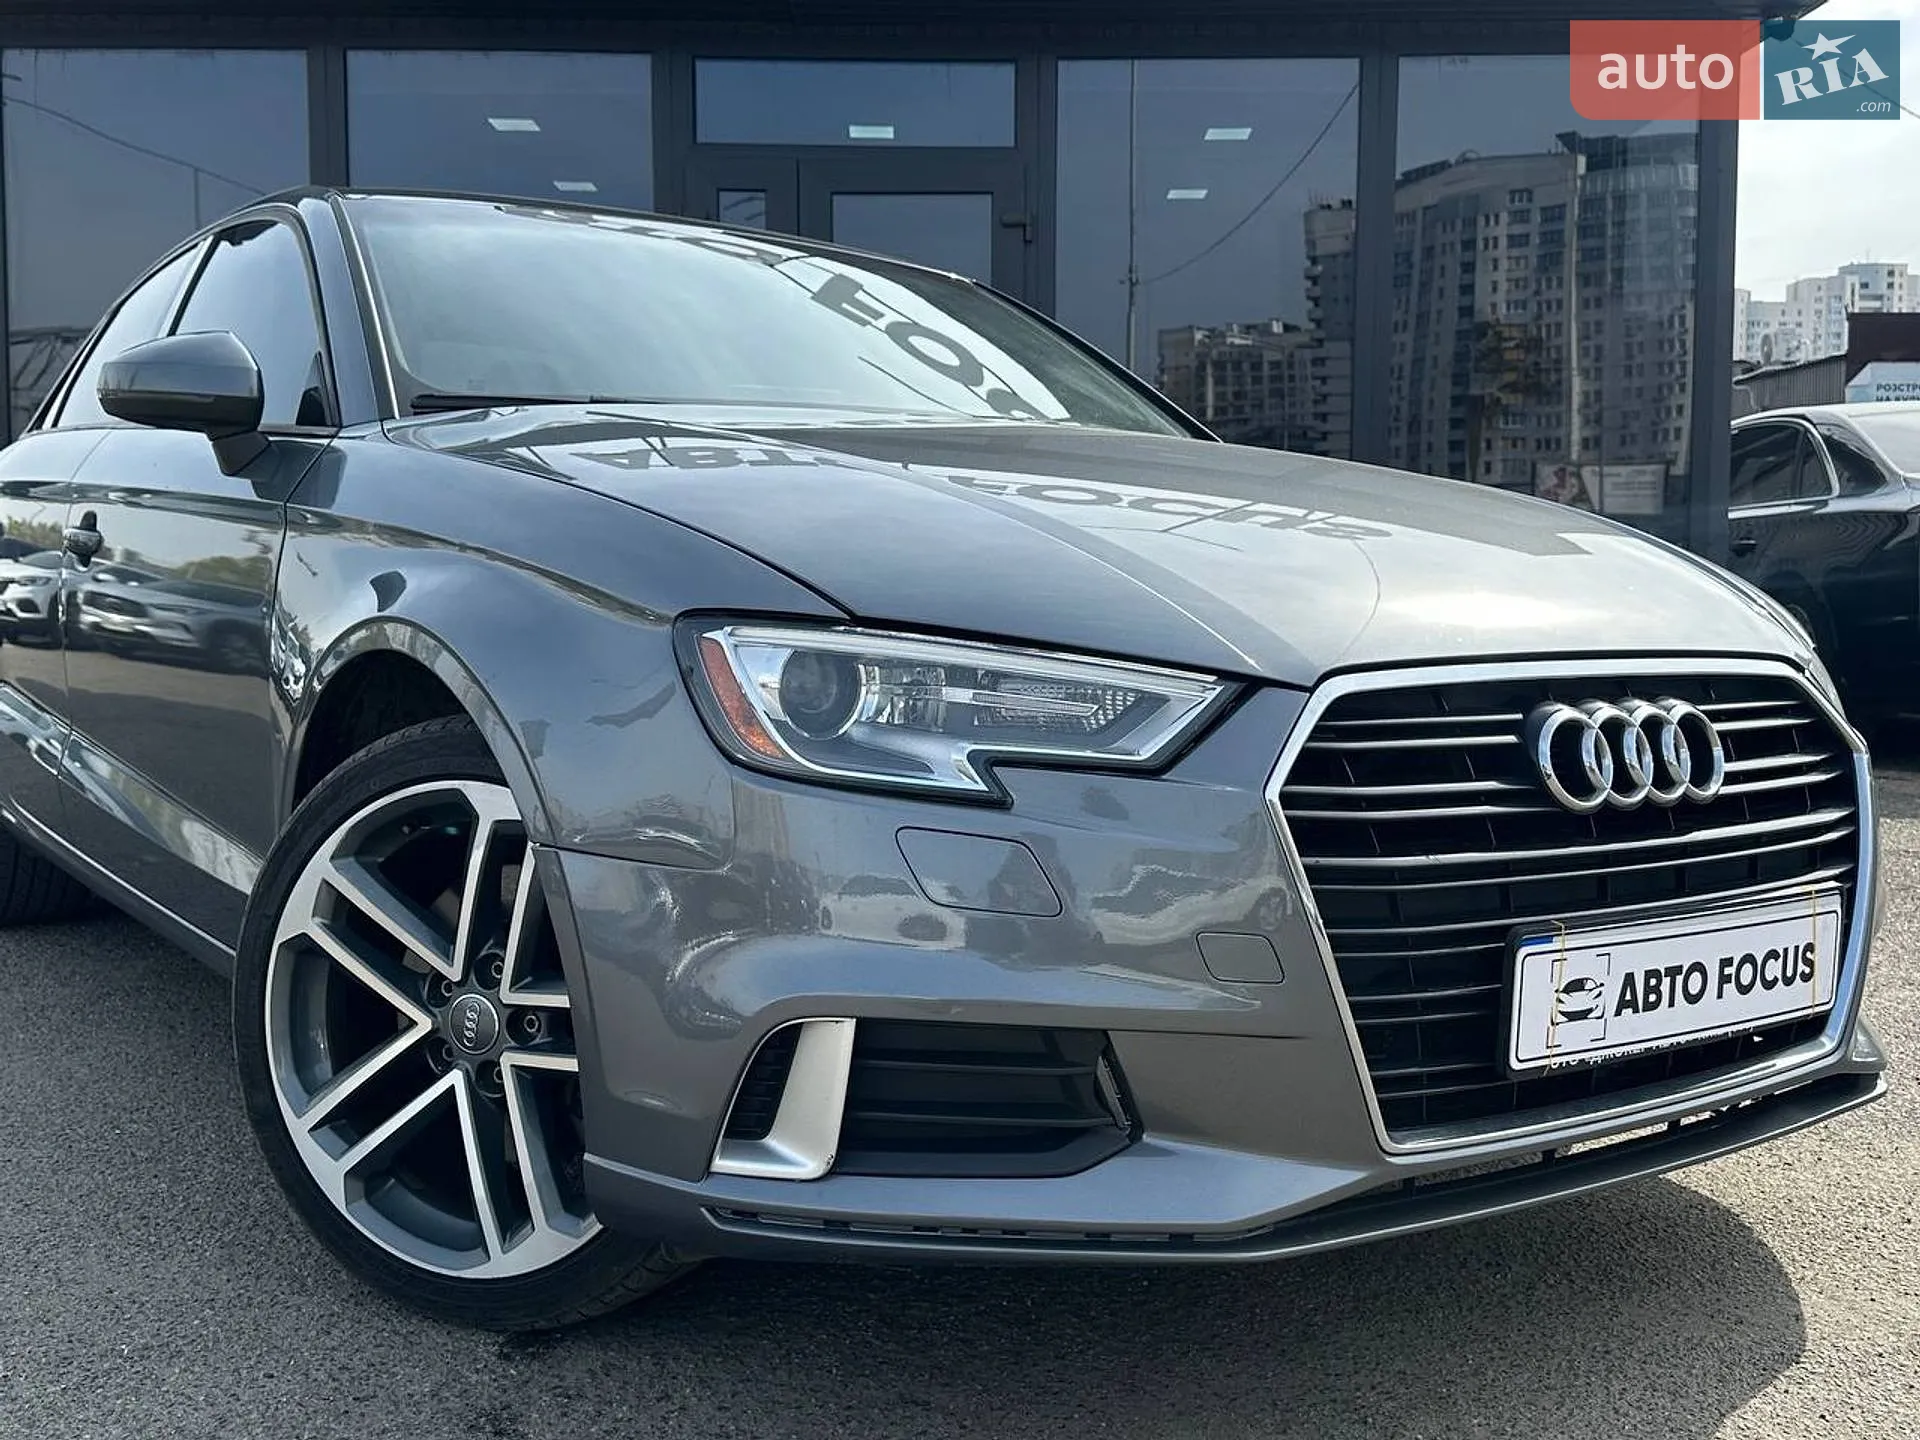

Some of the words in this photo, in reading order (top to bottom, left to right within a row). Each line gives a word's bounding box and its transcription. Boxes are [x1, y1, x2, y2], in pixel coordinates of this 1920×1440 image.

[1876, 383, 1920, 392] РОЗСТР
[1614, 961, 1708, 1017] АВТО
[1716, 942, 1817, 999] FOCUS
